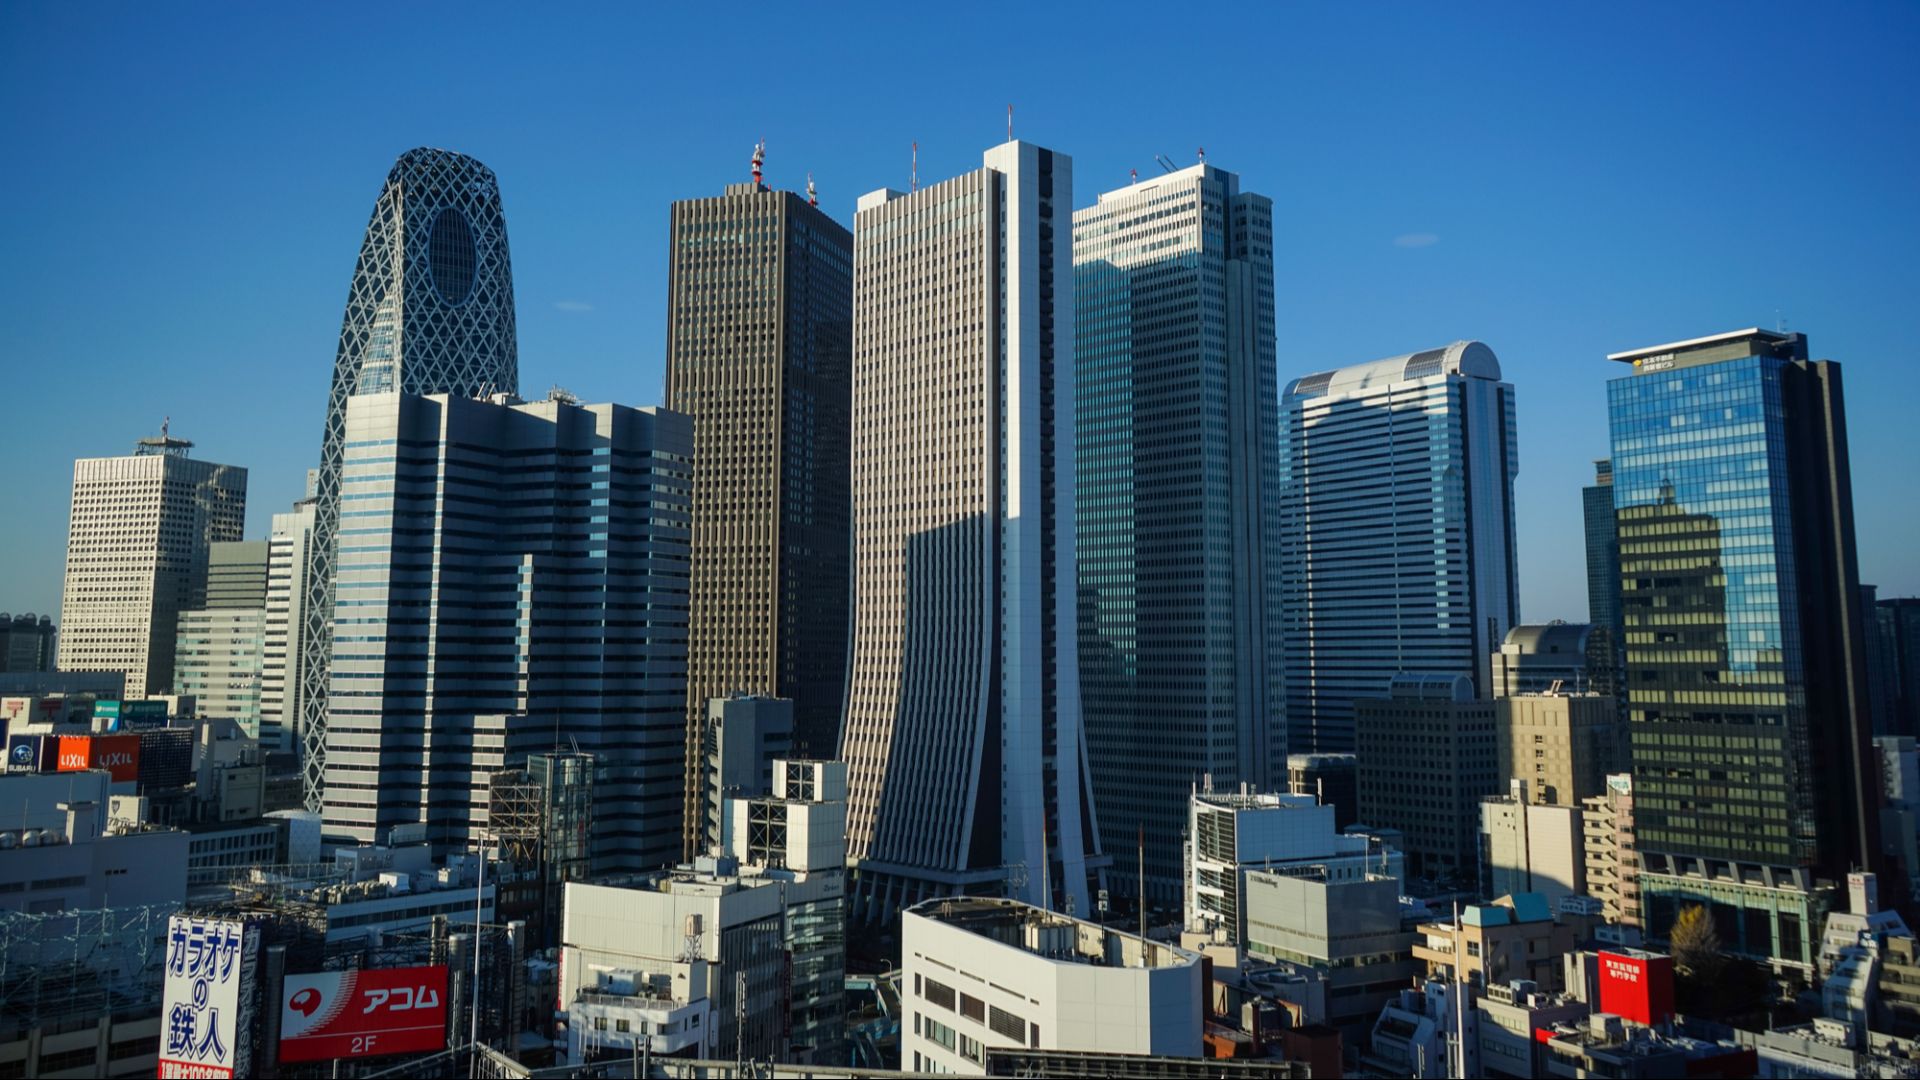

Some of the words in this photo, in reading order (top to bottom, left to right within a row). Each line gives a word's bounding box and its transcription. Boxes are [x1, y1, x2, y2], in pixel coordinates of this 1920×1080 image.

[8, 764, 37, 773] SUBARU
[60, 752, 86, 768] LIXIL
[99, 752, 133, 767] LIXIL
[168, 919, 240, 984] カラオケ
[192, 974, 209, 1011] の
[232, 925, 261, 1079] カラオケの鉄
[363, 985, 440, 1014] アコム
[167, 1004, 227, 1063] 鉄人
[351, 1035, 378, 1053] 2F
